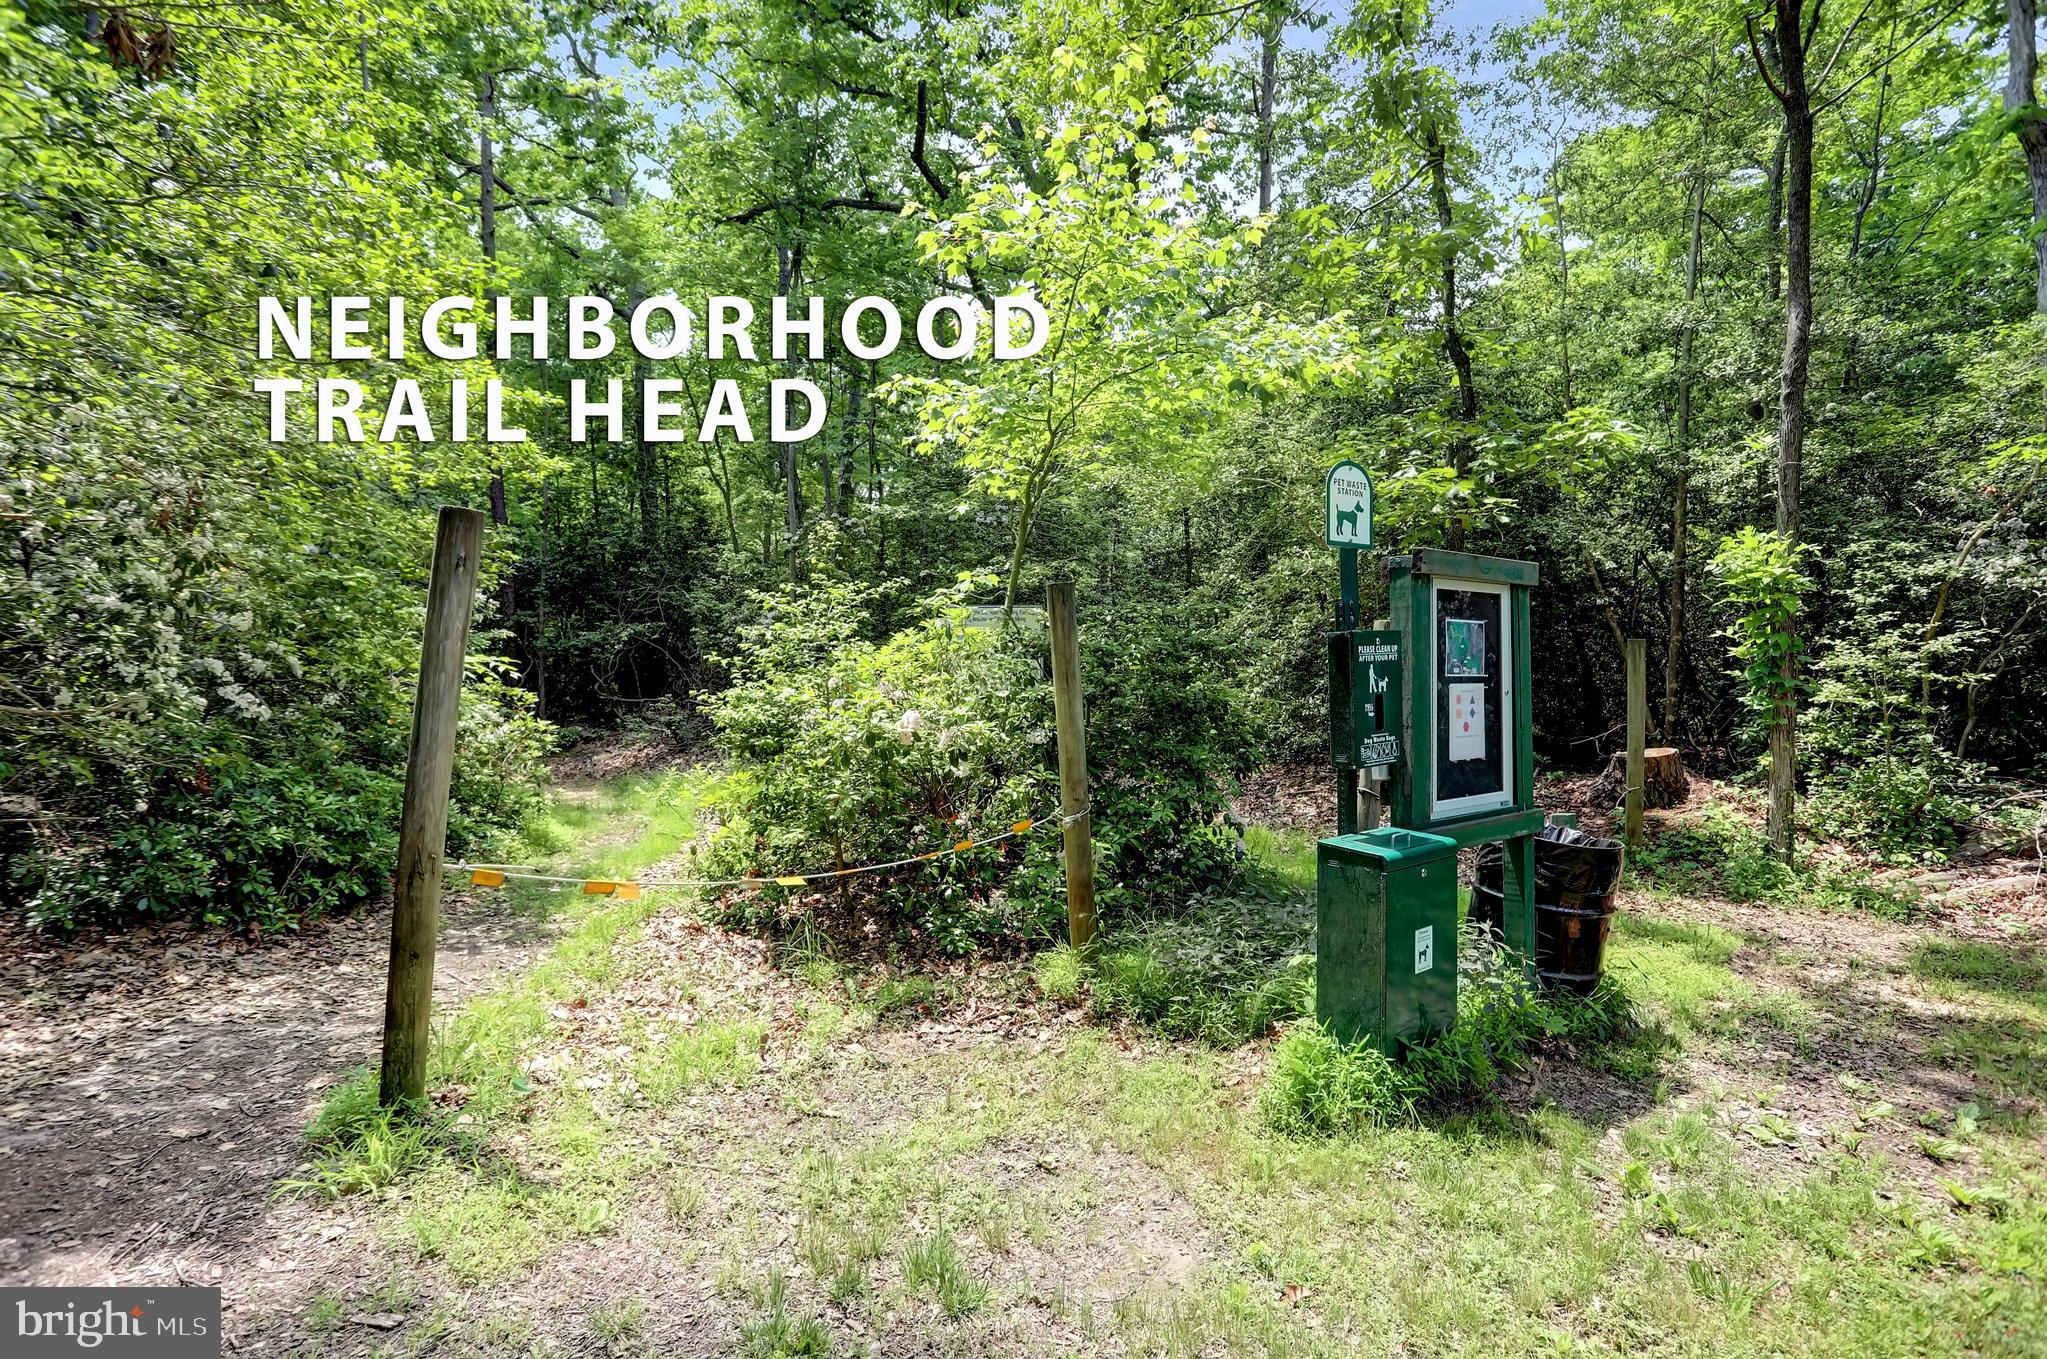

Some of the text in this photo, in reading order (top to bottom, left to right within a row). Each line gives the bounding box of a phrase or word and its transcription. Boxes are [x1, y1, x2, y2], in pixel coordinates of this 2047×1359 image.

[1334, 478, 1367, 490] PET WASTE
[1338, 488, 1363, 498] STATION
[1358, 645, 1375, 653] PLEASE
[1375, 644, 1391, 652] CLEAN
[1374, 654, 1388, 662] YOUR
